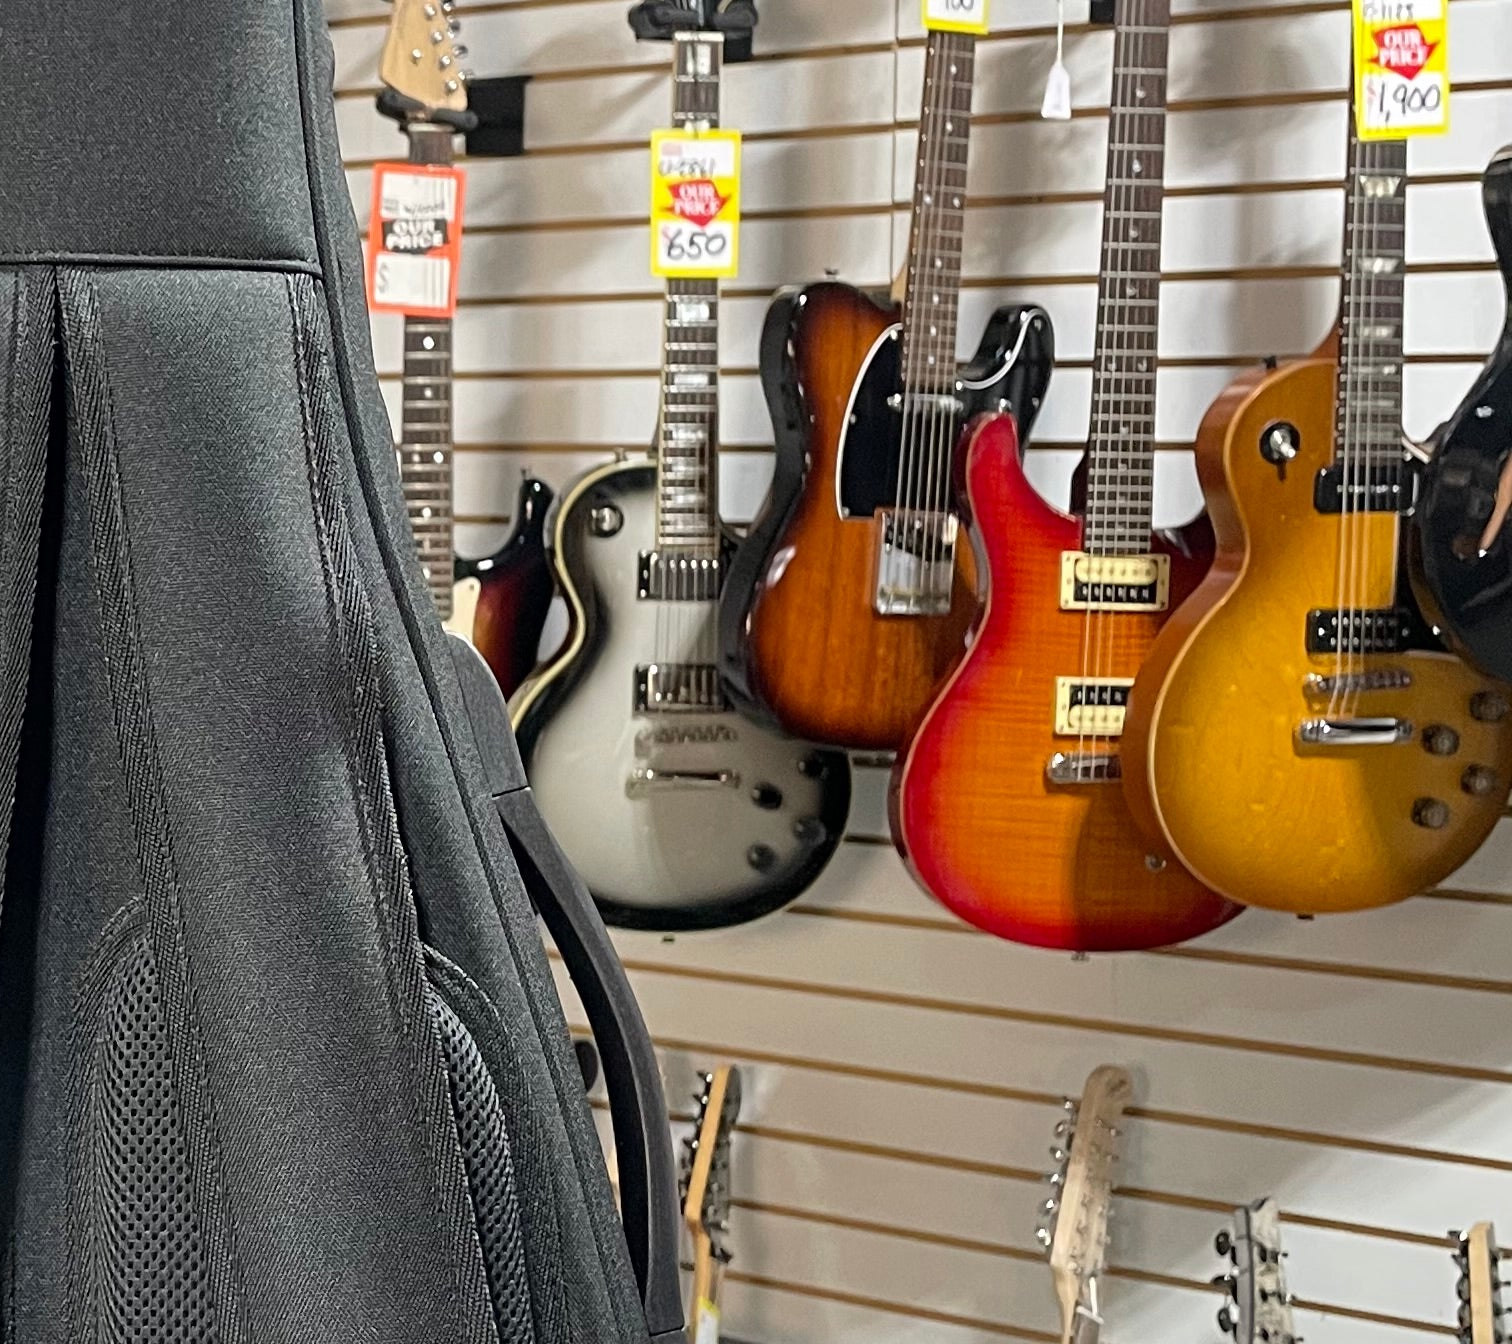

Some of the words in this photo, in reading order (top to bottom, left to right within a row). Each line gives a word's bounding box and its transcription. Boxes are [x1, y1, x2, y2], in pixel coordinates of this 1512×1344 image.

[1382, 29, 1422, 48] OUR
[1378, 47, 1431, 67] PRICE
[678, 183, 715, 200] OUR
[673, 199, 720, 216] PRICE
[392, 219, 436, 237] OUR
[385, 232, 444, 250] PRICE
